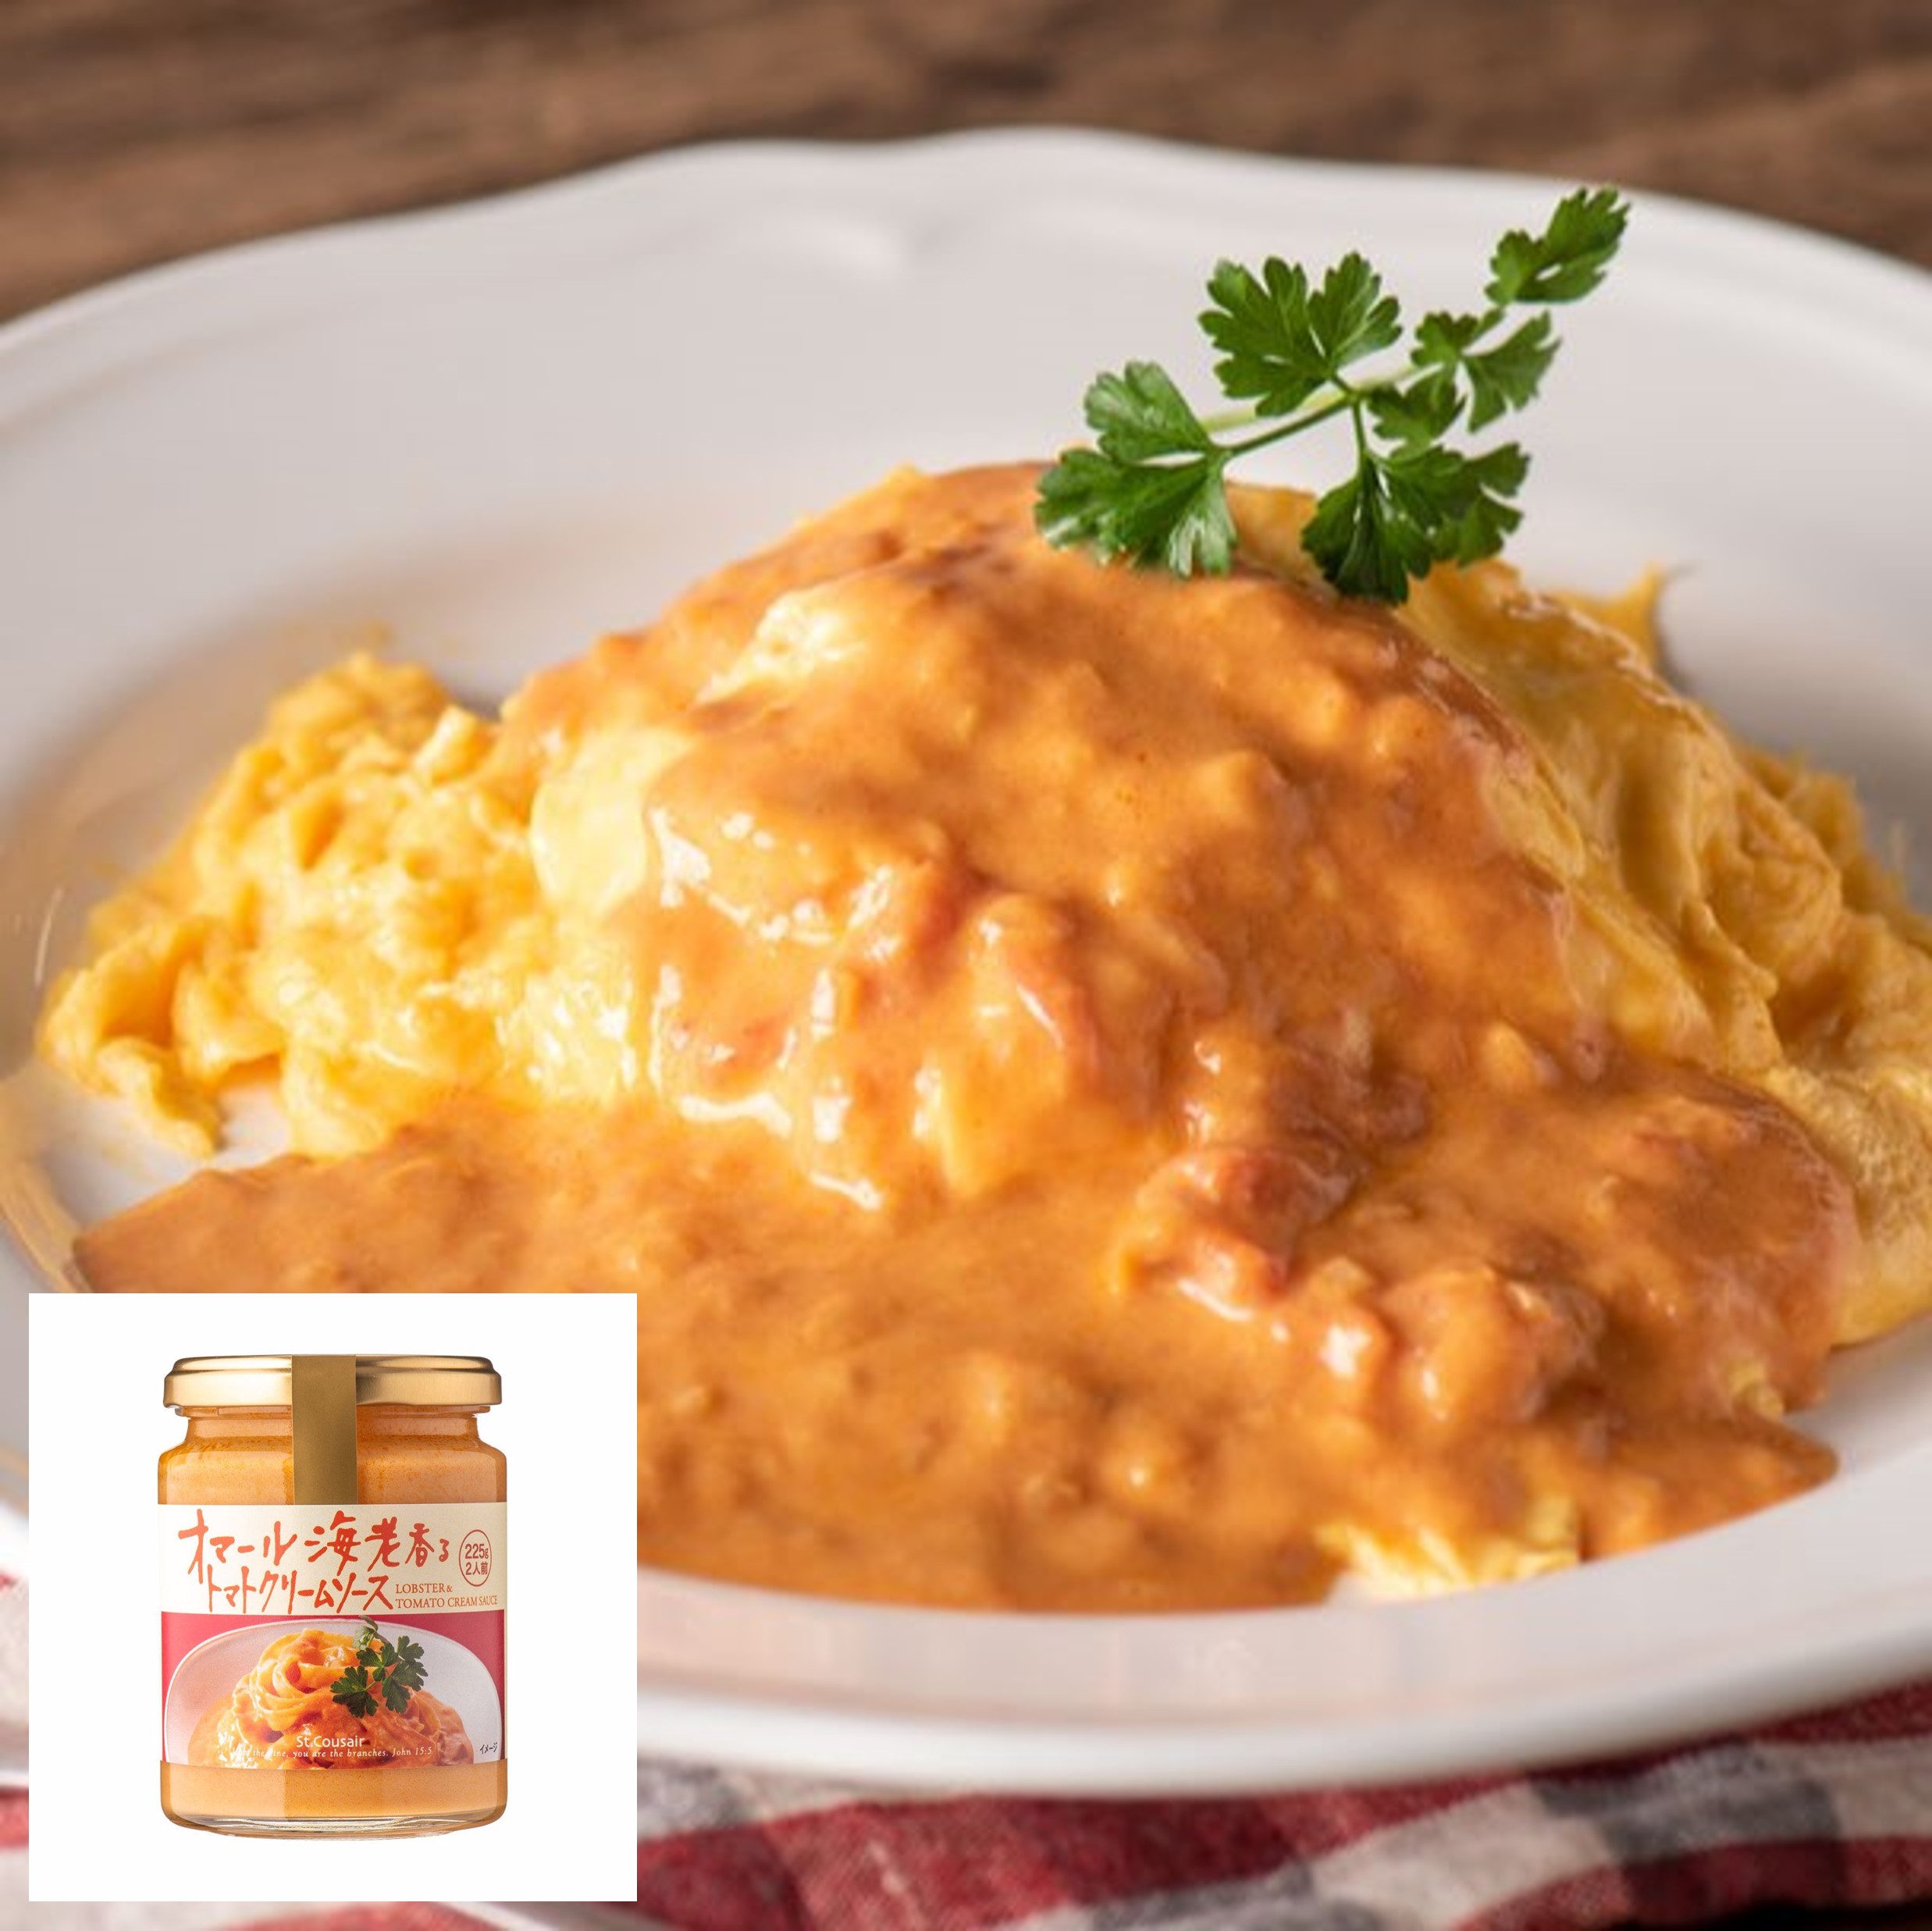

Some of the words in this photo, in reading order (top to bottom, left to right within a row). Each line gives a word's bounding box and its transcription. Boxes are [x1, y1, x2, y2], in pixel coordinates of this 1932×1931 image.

[178, 1508, 450, 1584] オマール海老香る
[464, 1543, 489, 1559] 225g
[465, 1561, 489, 1576] 2人前
[207, 1563, 393, 1614] トマトクリームソース
[395, 1598, 445, 1609] TOMATO
[447, 1597, 478, 1608] CREAM
[479, 1595, 498, 1606] SAUCE
[268, 1748, 289, 1758] ine,
[293, 1751, 308, 1759] you
[330, 1748, 343, 1758] the
[347, 1748, 388, 1758] branches.
[392, 1748, 411, 1758] John
[415, 1746, 432, 1755] 15:5
[479, 1742, 498, 1755] イメージ
